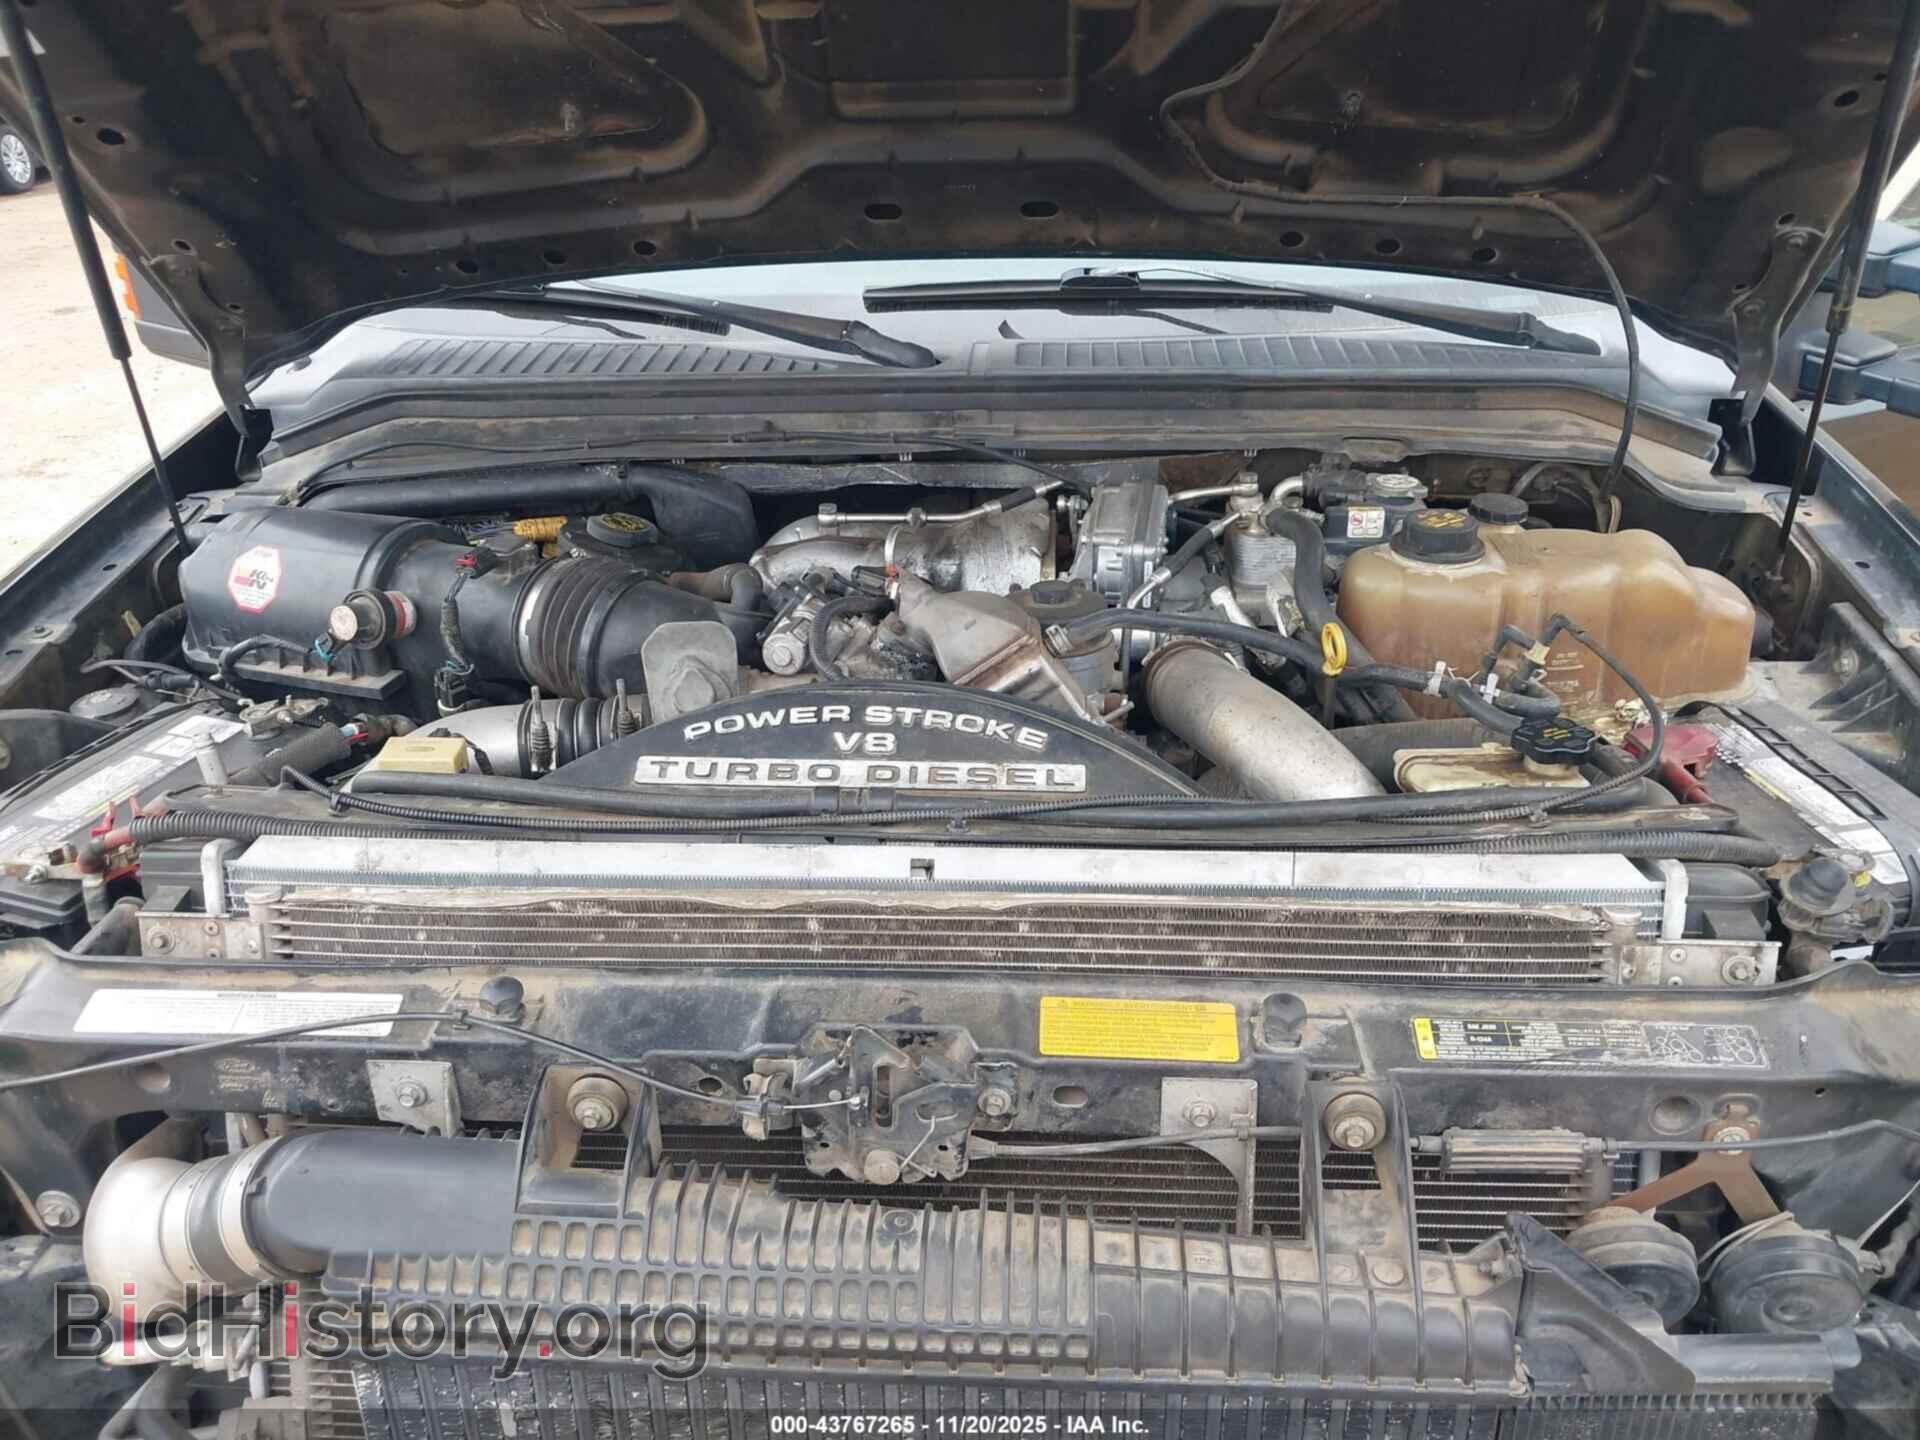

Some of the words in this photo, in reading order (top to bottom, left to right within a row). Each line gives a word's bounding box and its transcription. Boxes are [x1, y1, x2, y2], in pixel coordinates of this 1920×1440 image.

[684, 705, 851, 741] POWER
[865, 706, 1048, 749] STROKE
[834, 731, 896, 754] V8
[650, 760, 840, 782] TURBO
[866, 765, 1076, 787] DIESEL
